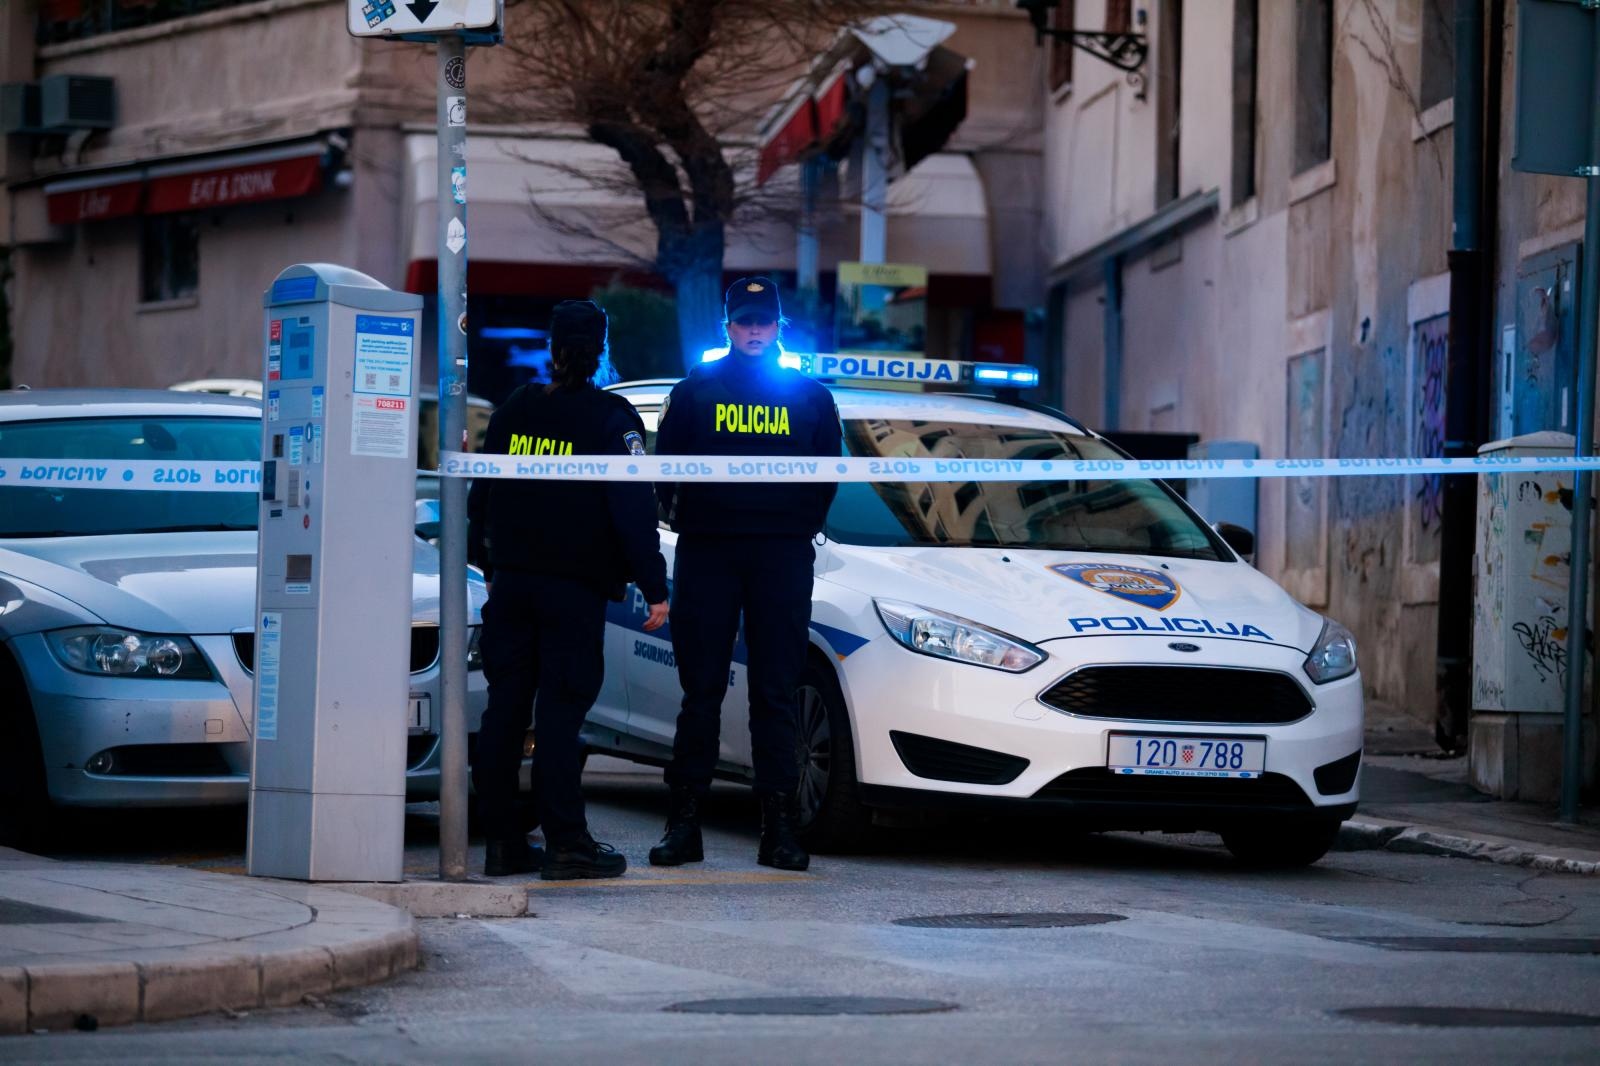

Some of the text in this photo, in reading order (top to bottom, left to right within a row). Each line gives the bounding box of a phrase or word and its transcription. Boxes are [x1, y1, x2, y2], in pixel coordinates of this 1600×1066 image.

[189, 178, 216, 204] EAT
[232, 169, 277, 200] DRINK
[821, 357, 953, 381] POLICIJA
[377, 400, 404, 409] 708211
[715, 404, 790, 435] POLICIJA
[1056, 563, 1162, 576] POLICIJA
[1068, 617, 1274, 640] POLICIJA
[634, 639, 678, 668] SIGURNOS
[1135, 740, 1244, 769] 120 788
